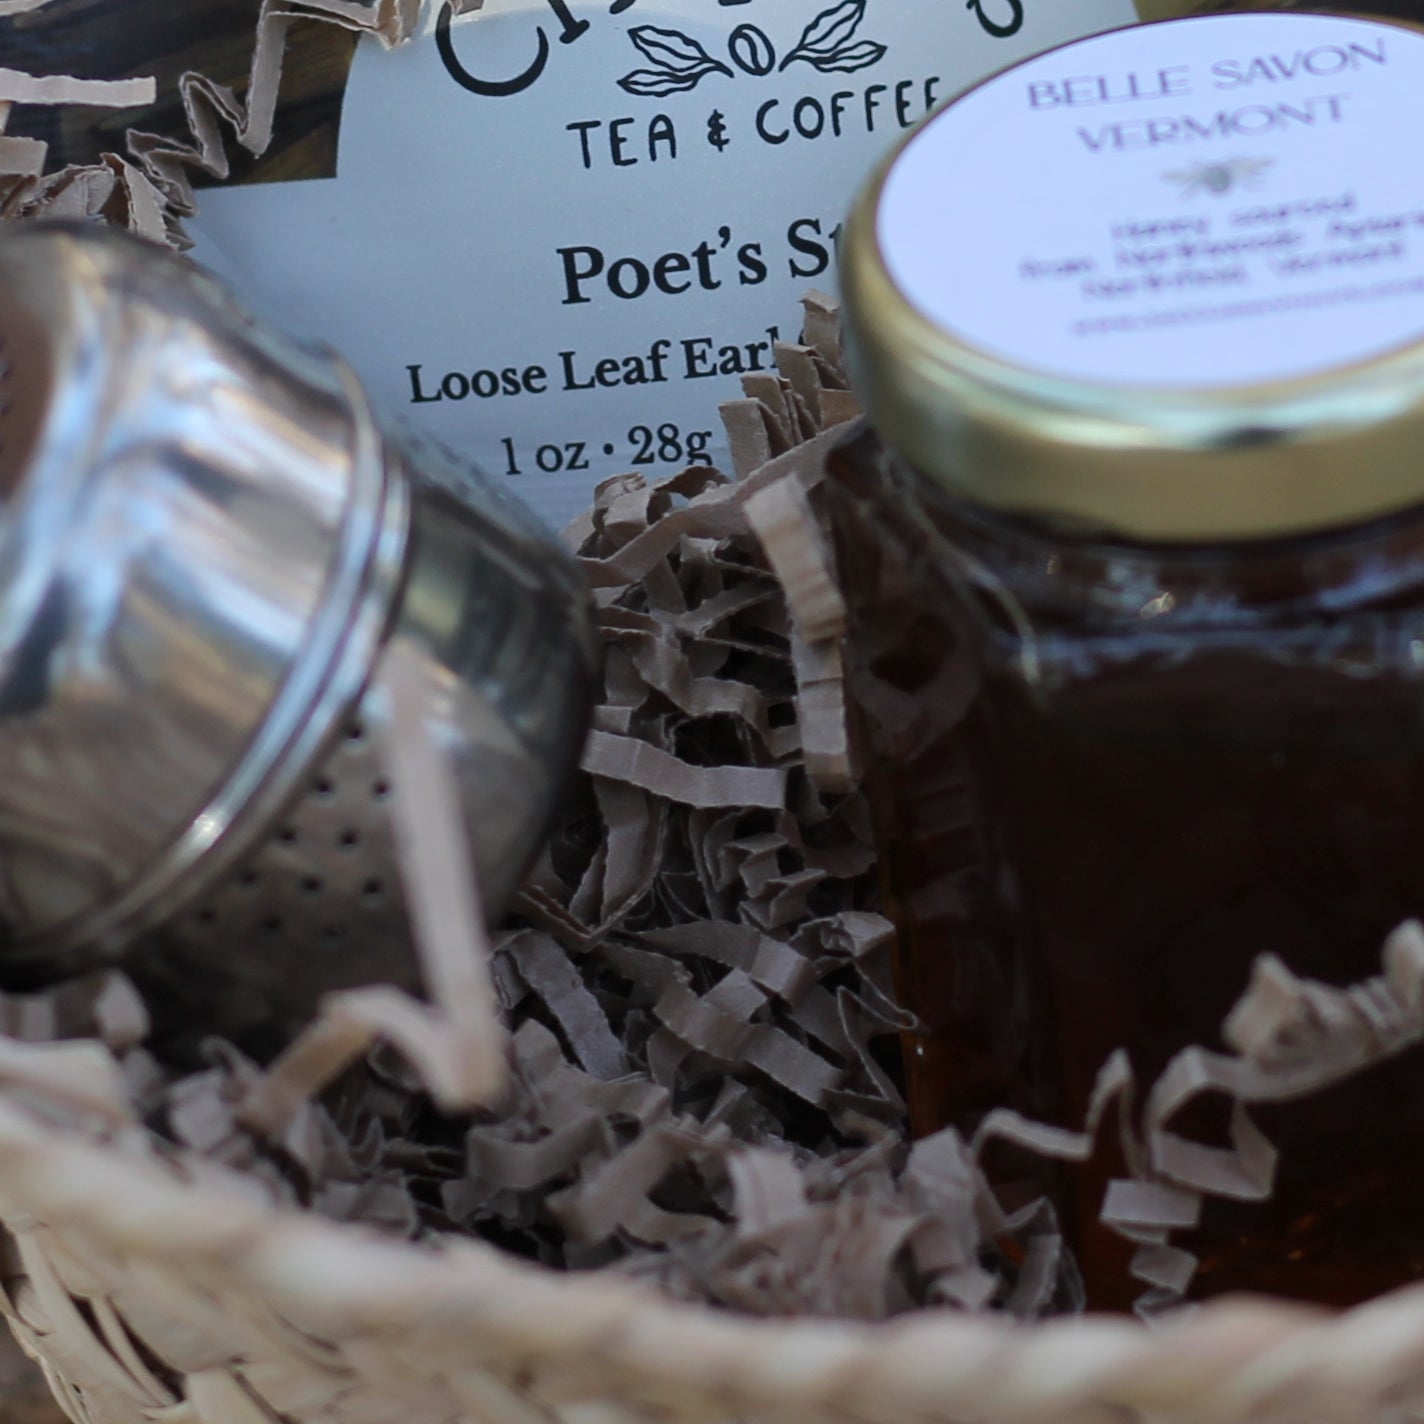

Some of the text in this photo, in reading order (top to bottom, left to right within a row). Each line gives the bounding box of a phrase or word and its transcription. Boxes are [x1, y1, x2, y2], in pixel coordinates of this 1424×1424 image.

[1027, 38, 1387, 110] BELLE SAVON
[565, 113, 677, 169] TEA
[706, 109, 731, 153] &
[1077, 92, 1353, 153] VERMONT
[555, 218, 843, 305] Poet's S
[405, 363, 548, 404] Loose
[558, 339, 672, 392] Leaf
[535, 441, 590, 474] oz
[627, 422, 713, 467] 28g
